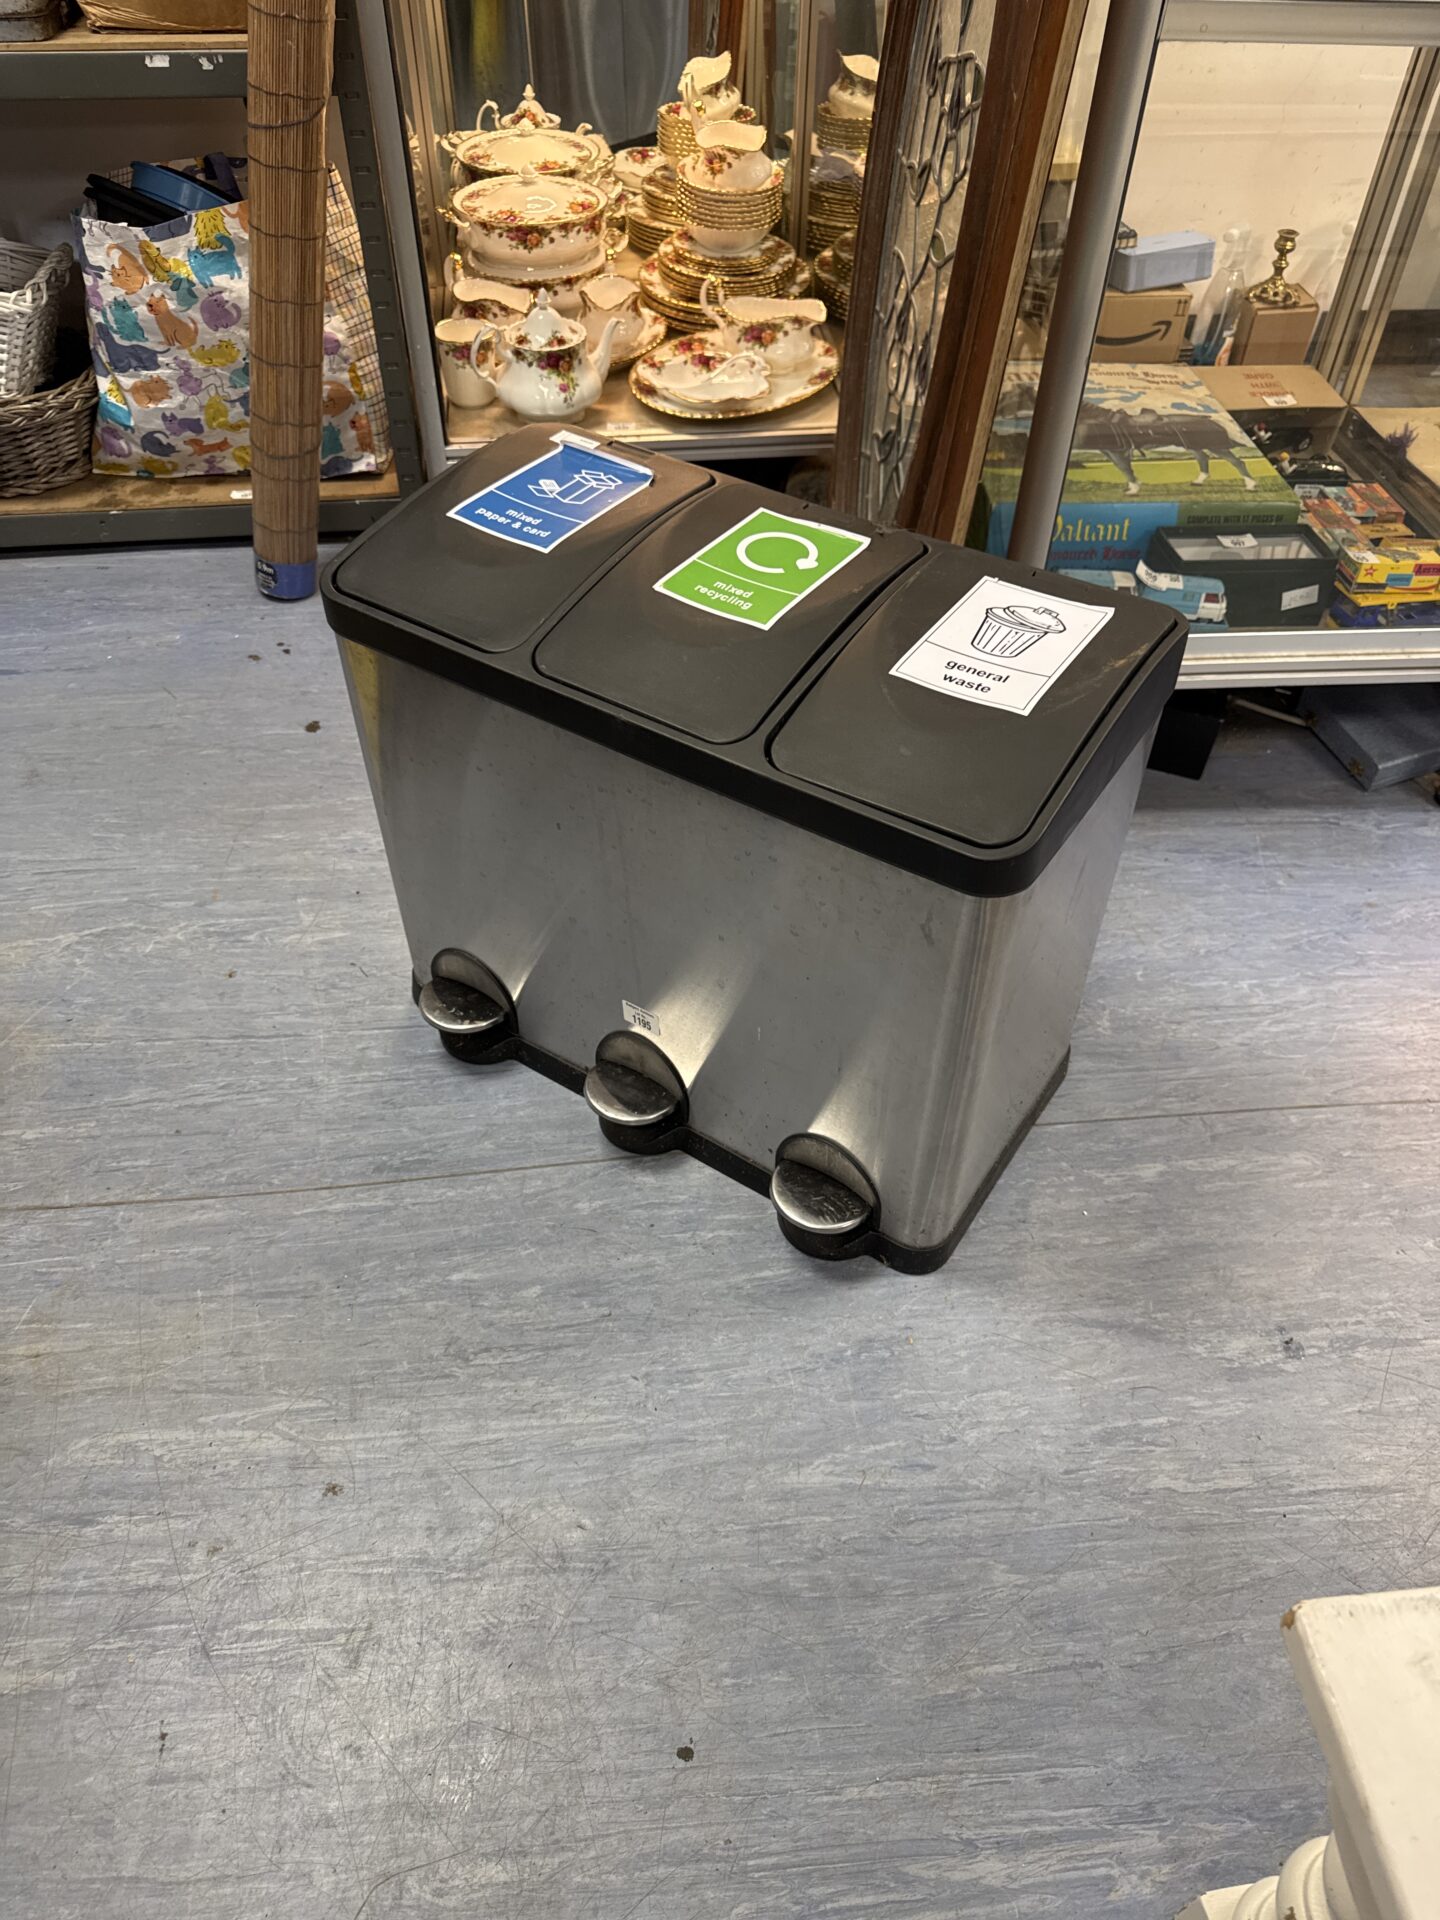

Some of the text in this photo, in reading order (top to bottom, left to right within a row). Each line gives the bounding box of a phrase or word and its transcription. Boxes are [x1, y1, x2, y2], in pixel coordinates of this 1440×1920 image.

[474, 507, 552, 538] paper & card
[505, 509, 543, 525] mixed
[694, 585, 753, 610] recycling
[713, 581, 754, 598] mixed
[944, 660, 1010, 683] general
[943, 674, 991, 693] waste
